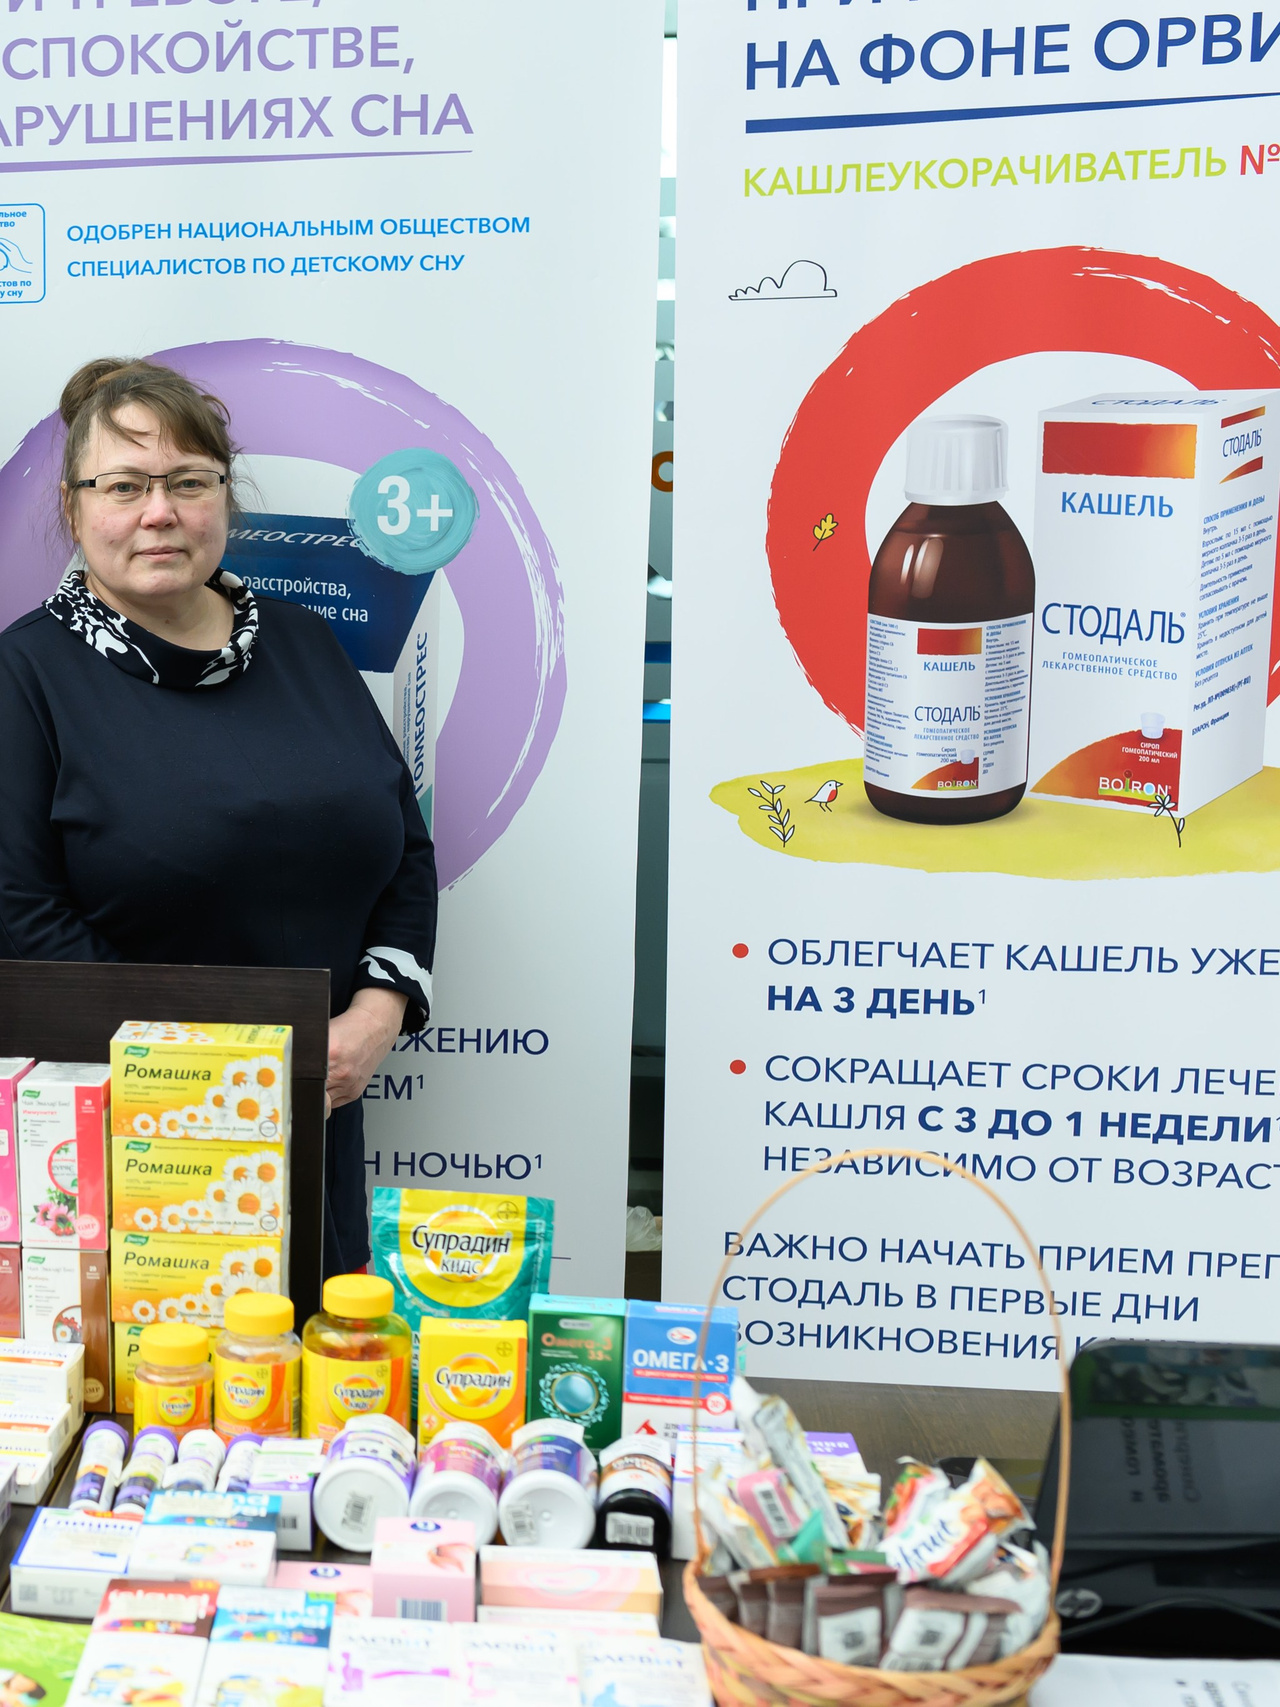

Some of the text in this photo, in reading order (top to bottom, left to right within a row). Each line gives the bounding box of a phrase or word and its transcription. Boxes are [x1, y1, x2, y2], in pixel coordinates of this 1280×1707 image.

[746, 39, 840, 90] НА
[860, 24, 1070, 84] ФОНЕ
[350, 93, 474, 138] СНА
[744, 147, 1227, 197] КАШЛЕУКОРАЧИВАТЕЛЬ
[67, 216, 530, 244] ОДОБРЕН НАЦИОНАЛЬНЫМ ОБЩЕСТВОМ
[67, 254, 465, 279] СПЕЦИАЛИСТОВ ПО ДЕТСКОМУ СНУ
[7, 289, 23, 299] сну
[20, 280, 32, 288] по
[1222, 428, 1262, 458] СТОДАЛЬ
[376, 475, 453, 536] 3+
[1061, 491, 1174, 518] КАШЕЛЬ
[242, 575, 351, 599] расстройства,
[342, 605, 368, 622] сна
[1042, 603, 1186, 646] СТОДАЛЬ
[923, 661, 975, 672] КАШЕЛЬ
[1042, 661, 1178, 681] ЛЕКАРСТВЕННОЕ СРЕДСТВО
[1062, 652, 1158, 668] ГОМЕОПАТИЧЕСКОЕ
[914, 705, 981, 725] СТОДАЛЬ
[1122, 747, 1178, 759] ГОМЕОПАТИЧЕСКИЙ
[1140, 742, 1160, 750] СИРОП
[1138, 755, 1149, 763] 200
[937, 778, 978, 788] BOIRON
[1099, 771, 1171, 796] BOIRON
[768, 938, 1280, 977] ОБЛЕГЧАЕТ КАШЕЛЬ УЖЕ
[767, 985, 821, 1013] НА
[833, 986, 855, 1013] 3
[124, 1064, 212, 1081] Ромашка
[764, 1054, 1280, 1097] СОКРАЩАЕТ СРОКИ ЛЕЧЕ
[763, 1100, 906, 1132] КАШЛЯ
[918, 1105, 944, 1132] С
[955, 1106, 977, 1133] 3
[988, 1109, 1052, 1140] ДО
[1066, 1111, 1081, 1137] 1
[125, 1159, 212, 1176] Ромашка
[763, 1146, 1036, 1182] НЕЗАВИСИМО
[1048, 1156, 1102, 1184] ОТ
[412, 1225, 511, 1253] Супрадин
[124, 1251, 210, 1270] Ромашка
[723, 1232, 868, 1263] ВАЖНО
[880, 1238, 1025, 1270] НАЧАТЬ
[1039, 1245, 1174, 1276] ПРИЕМ
[722, 1275, 1199, 1324] СТОДАЛЬ В ПЕРВЫЕ ДНИ
[436, 1368, 512, 1388] Супрадин
